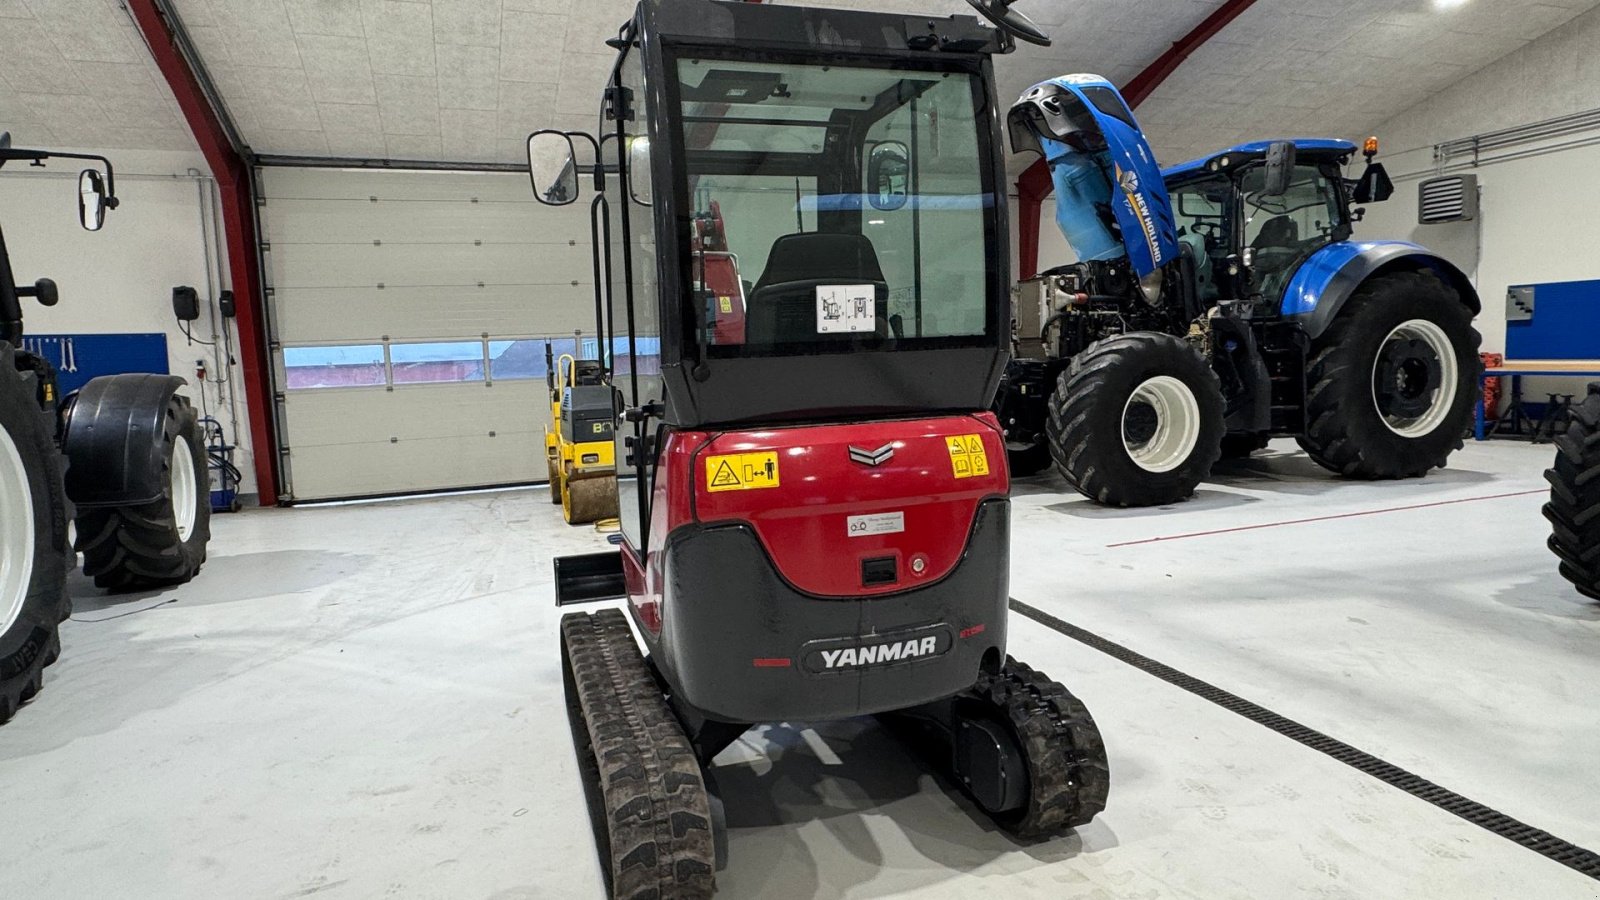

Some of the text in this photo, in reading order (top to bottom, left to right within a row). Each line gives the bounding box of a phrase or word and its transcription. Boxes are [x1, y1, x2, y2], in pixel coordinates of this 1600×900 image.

[1134, 192, 1162, 262] NEW HOLLAND
[820, 636, 936, 668] YANMAR
